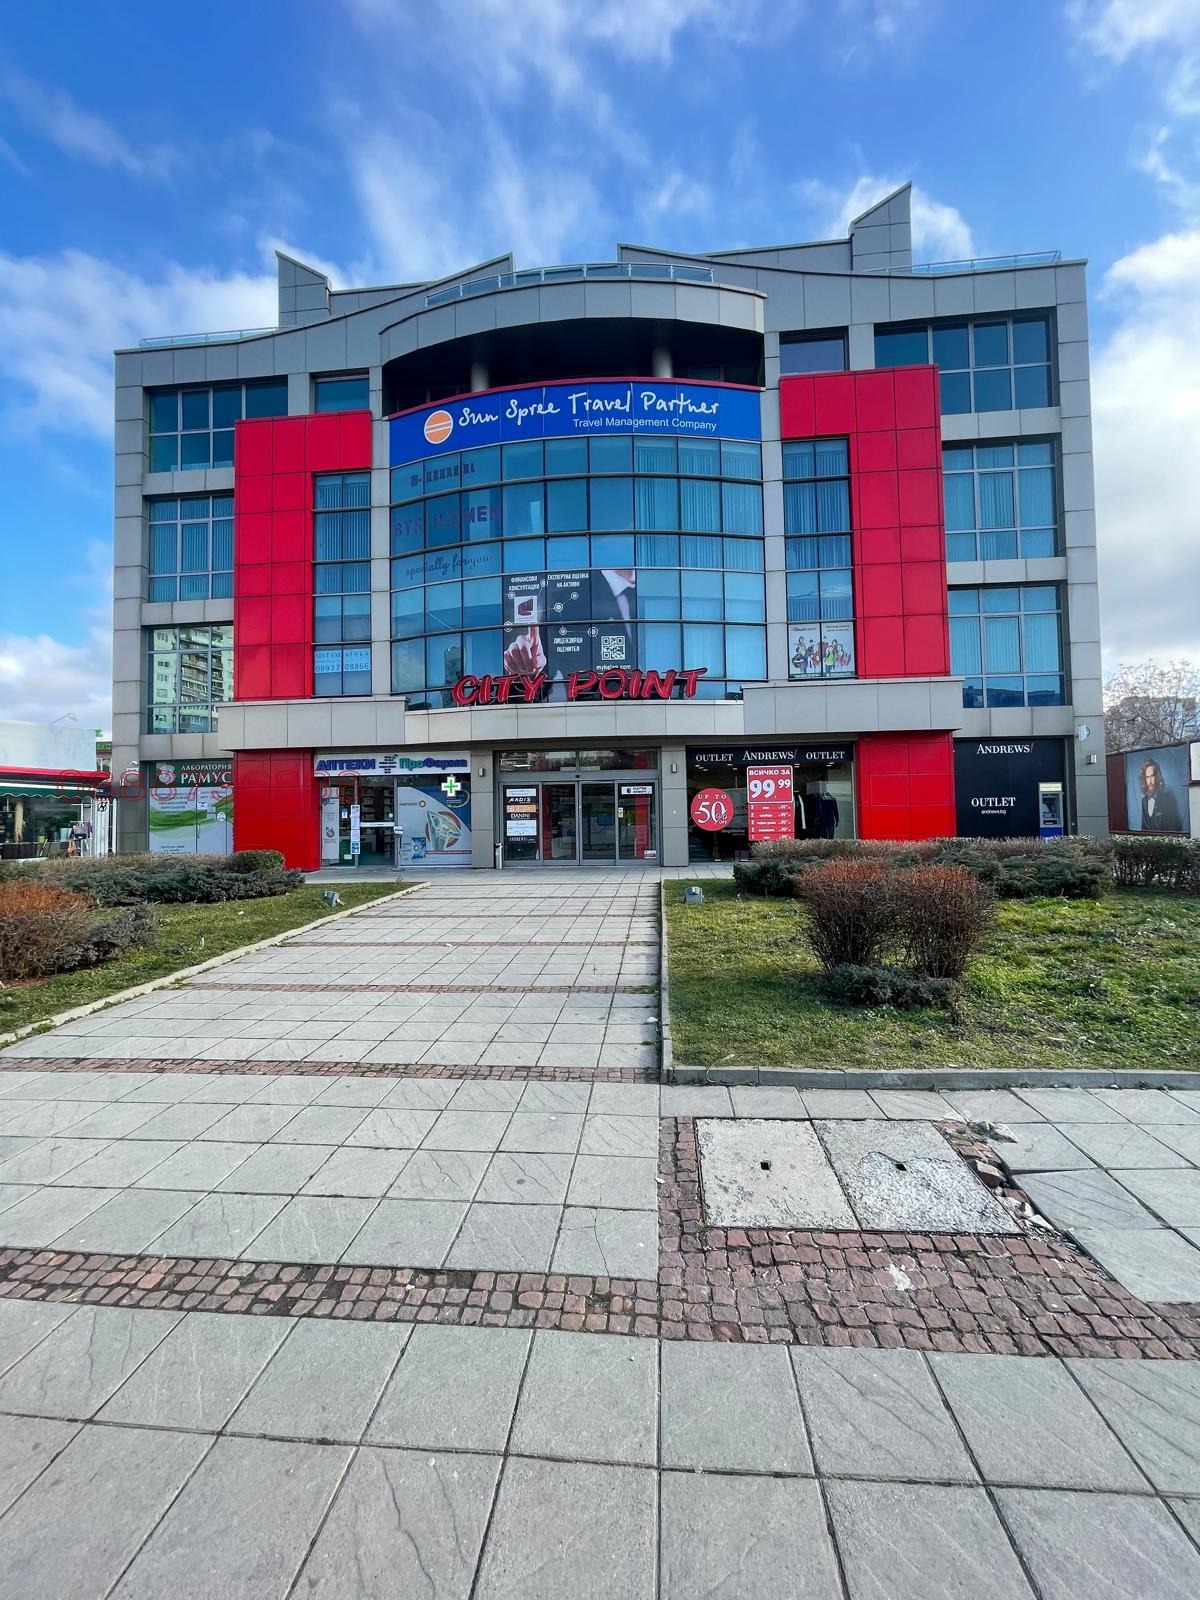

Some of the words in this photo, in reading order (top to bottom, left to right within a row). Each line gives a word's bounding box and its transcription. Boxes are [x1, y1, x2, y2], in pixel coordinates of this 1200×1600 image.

[458, 407, 499, 427] Sun
[505, 399, 561, 426] Spree
[567, 390, 631, 415] Travel
[640, 391, 720, 414] Partner
[572, 417, 603, 428] Travel
[605, 417, 670, 429] Management
[671, 418, 717, 432] Company
[451, 672, 548, 705] CITY
[567, 667, 708, 700] POINT
[695, 753, 734, 762] OUTLET
[805, 751, 845, 760] OUTLET
[180, 763, 232, 772] ЛАБОРАТОРИЯ
[316, 758, 376, 771] АПТЕКИ
[180, 771, 232, 784] РАМУС
[749, 779, 775, 799] 99
[777, 778, 791, 788] 99
[971, 797, 1016, 807] OUTLET
